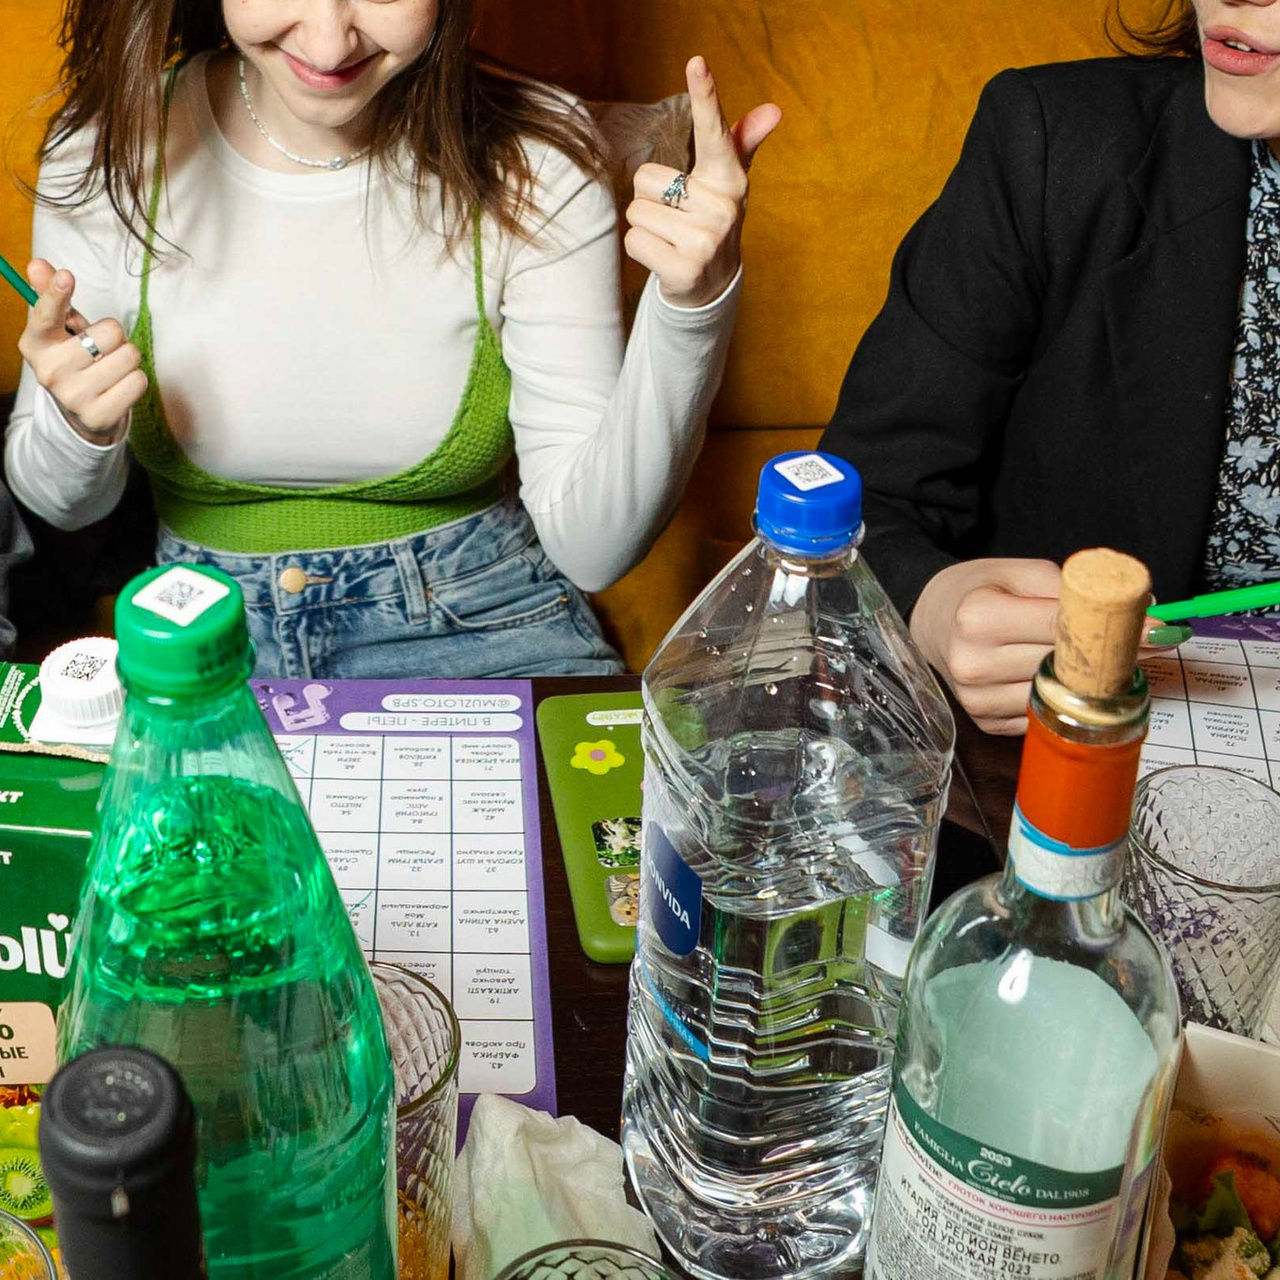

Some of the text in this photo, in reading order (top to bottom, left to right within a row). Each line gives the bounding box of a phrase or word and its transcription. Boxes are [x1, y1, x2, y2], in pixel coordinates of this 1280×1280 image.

[392, 698, 510, 708] @MUZLOTO.SPB
[368, 716, 406, 726] ПЕТЬ!
[421, 716, 477, 726] ПИТЕРЕ
[482, 717, 491, 726] В
[1210, 732, 1247, 742] ПОЛИНА
[914, 1120, 965, 1173] FAMIGLIA
[967, 1159, 1031, 1195] Cielo
[1036, 1189, 1061, 1199] DAL
[980, 1147, 1012, 1167] 2023
[948, 1179, 986, 1206] ГЛОТОК
[988, 1200, 1045, 1222] ХОРОШЕГО
[915, 1209, 938, 1237] ГОД
[941, 1228, 996, 1267] УРОЖАЯ
[1001, 1260, 1031, 1276] 2023
[945, 1221, 999, 1254] РЕГИОН
